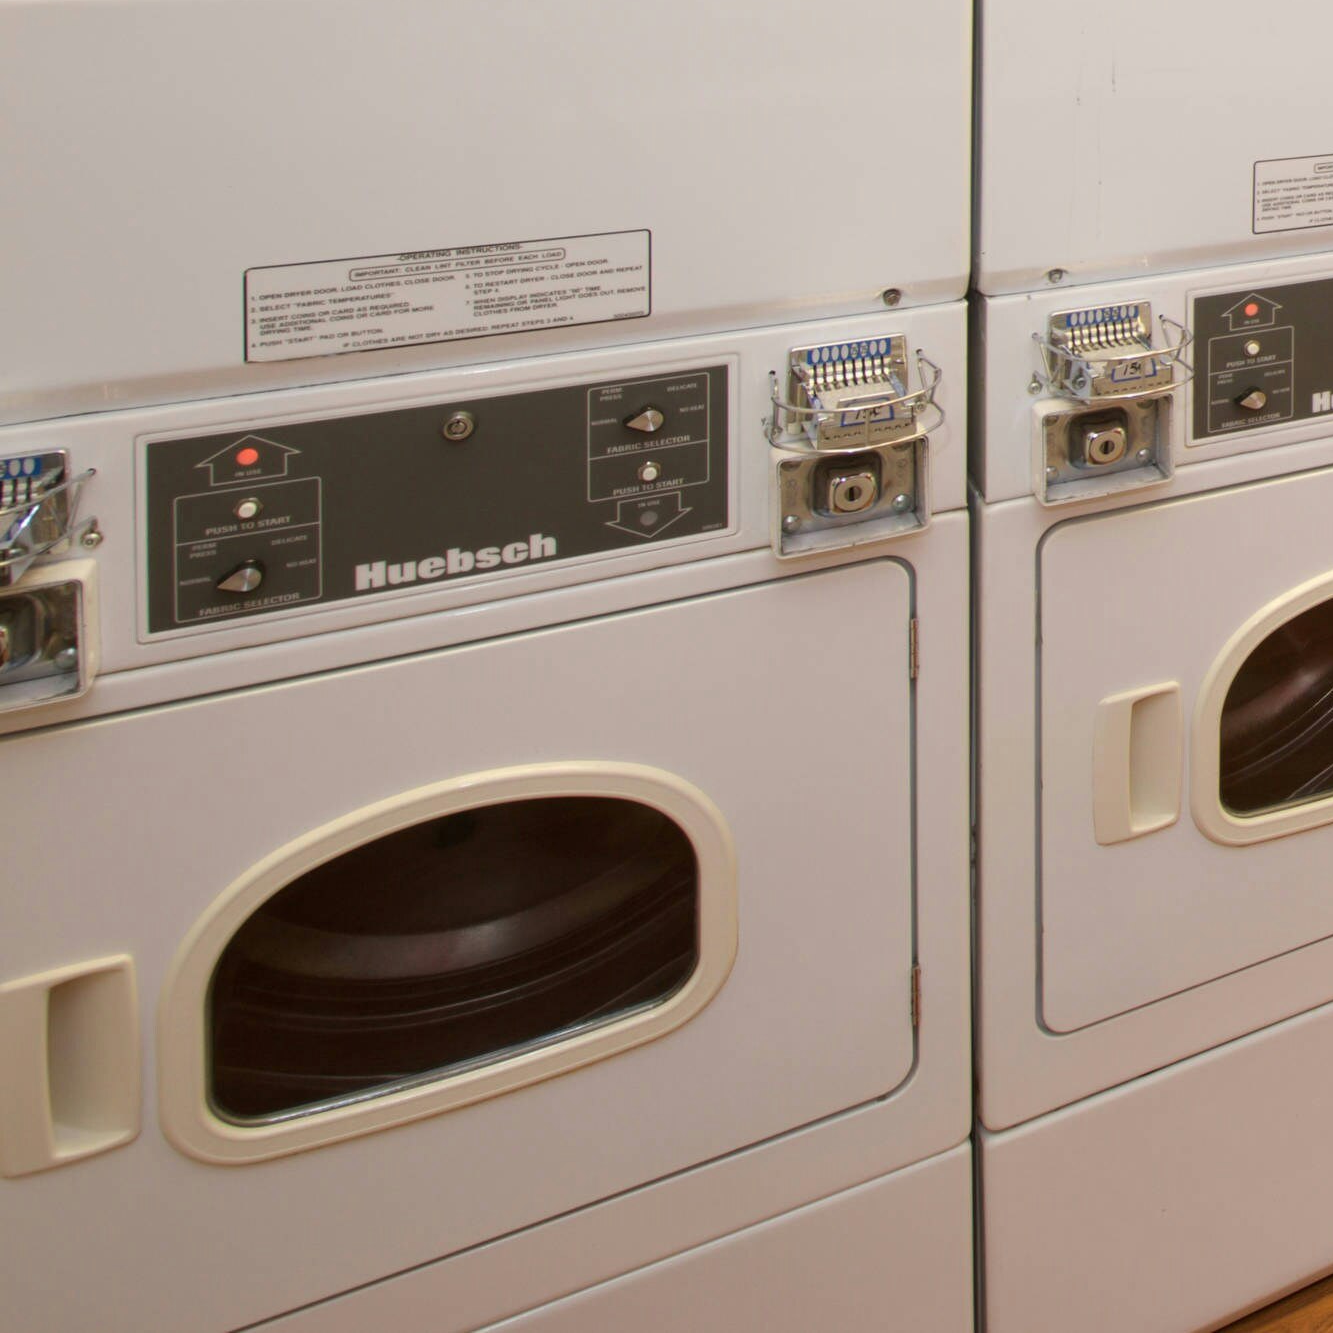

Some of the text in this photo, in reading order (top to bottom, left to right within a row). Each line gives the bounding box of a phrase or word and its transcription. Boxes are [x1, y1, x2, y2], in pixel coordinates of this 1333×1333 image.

[405, 264, 430, 272] CLEAN
[455, 259, 479, 267] FILTER
[484, 256, 513, 264] BEFORE
[518, 253, 538, 261] EACH
[542, 251, 561, 259] LOAD
[341, 284, 362, 292] LOAD
[404, 277, 429, 285] CLOSE
[485, 278, 517, 287] RESTART
[259, 302, 290, 312] SELECT
[259, 314, 287, 323] INSERT
[259, 339, 281, 347] PUSH
[352, 337, 387, 347] CLOTHES
[607, 434, 690, 454] FABRIC SELECTOR
[613, 484, 640, 496] PUSH
[656, 478, 684, 488] START
[206, 516, 292, 536] PUSH TO START
[354, 532, 558, 592] Huebsch
[200, 592, 300, 617] FABRIC SELECTOR
